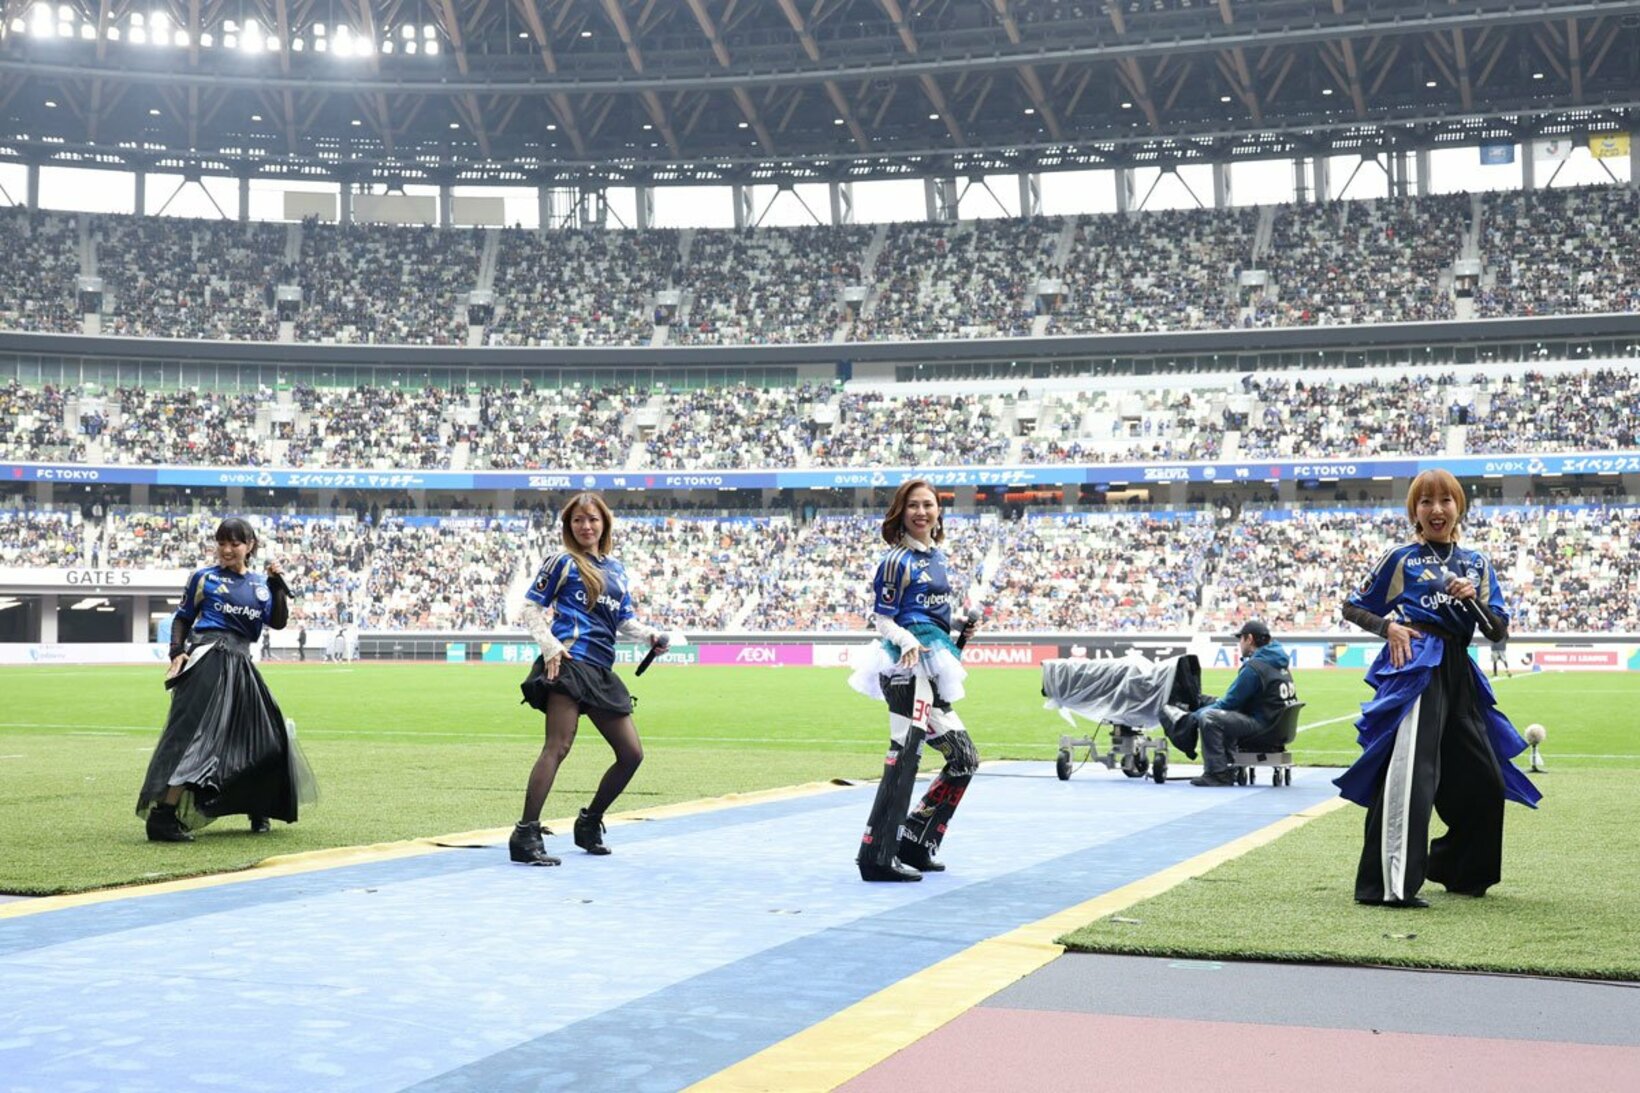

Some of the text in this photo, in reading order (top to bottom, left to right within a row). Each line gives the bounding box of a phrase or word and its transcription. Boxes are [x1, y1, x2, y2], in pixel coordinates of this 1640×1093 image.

[1294, 465, 1356, 476] FC TOKYO
[1485, 461, 1524, 471] avex
[37, 469, 99, 479] FC TOKYO
[666, 476, 723, 486] FC TOKYO
[835, 475, 868, 484] avex
[66, 570, 130, 585] GATE 5
[502, 644, 541, 662] 明治
[962, 648, 1032, 663] KONAMI
